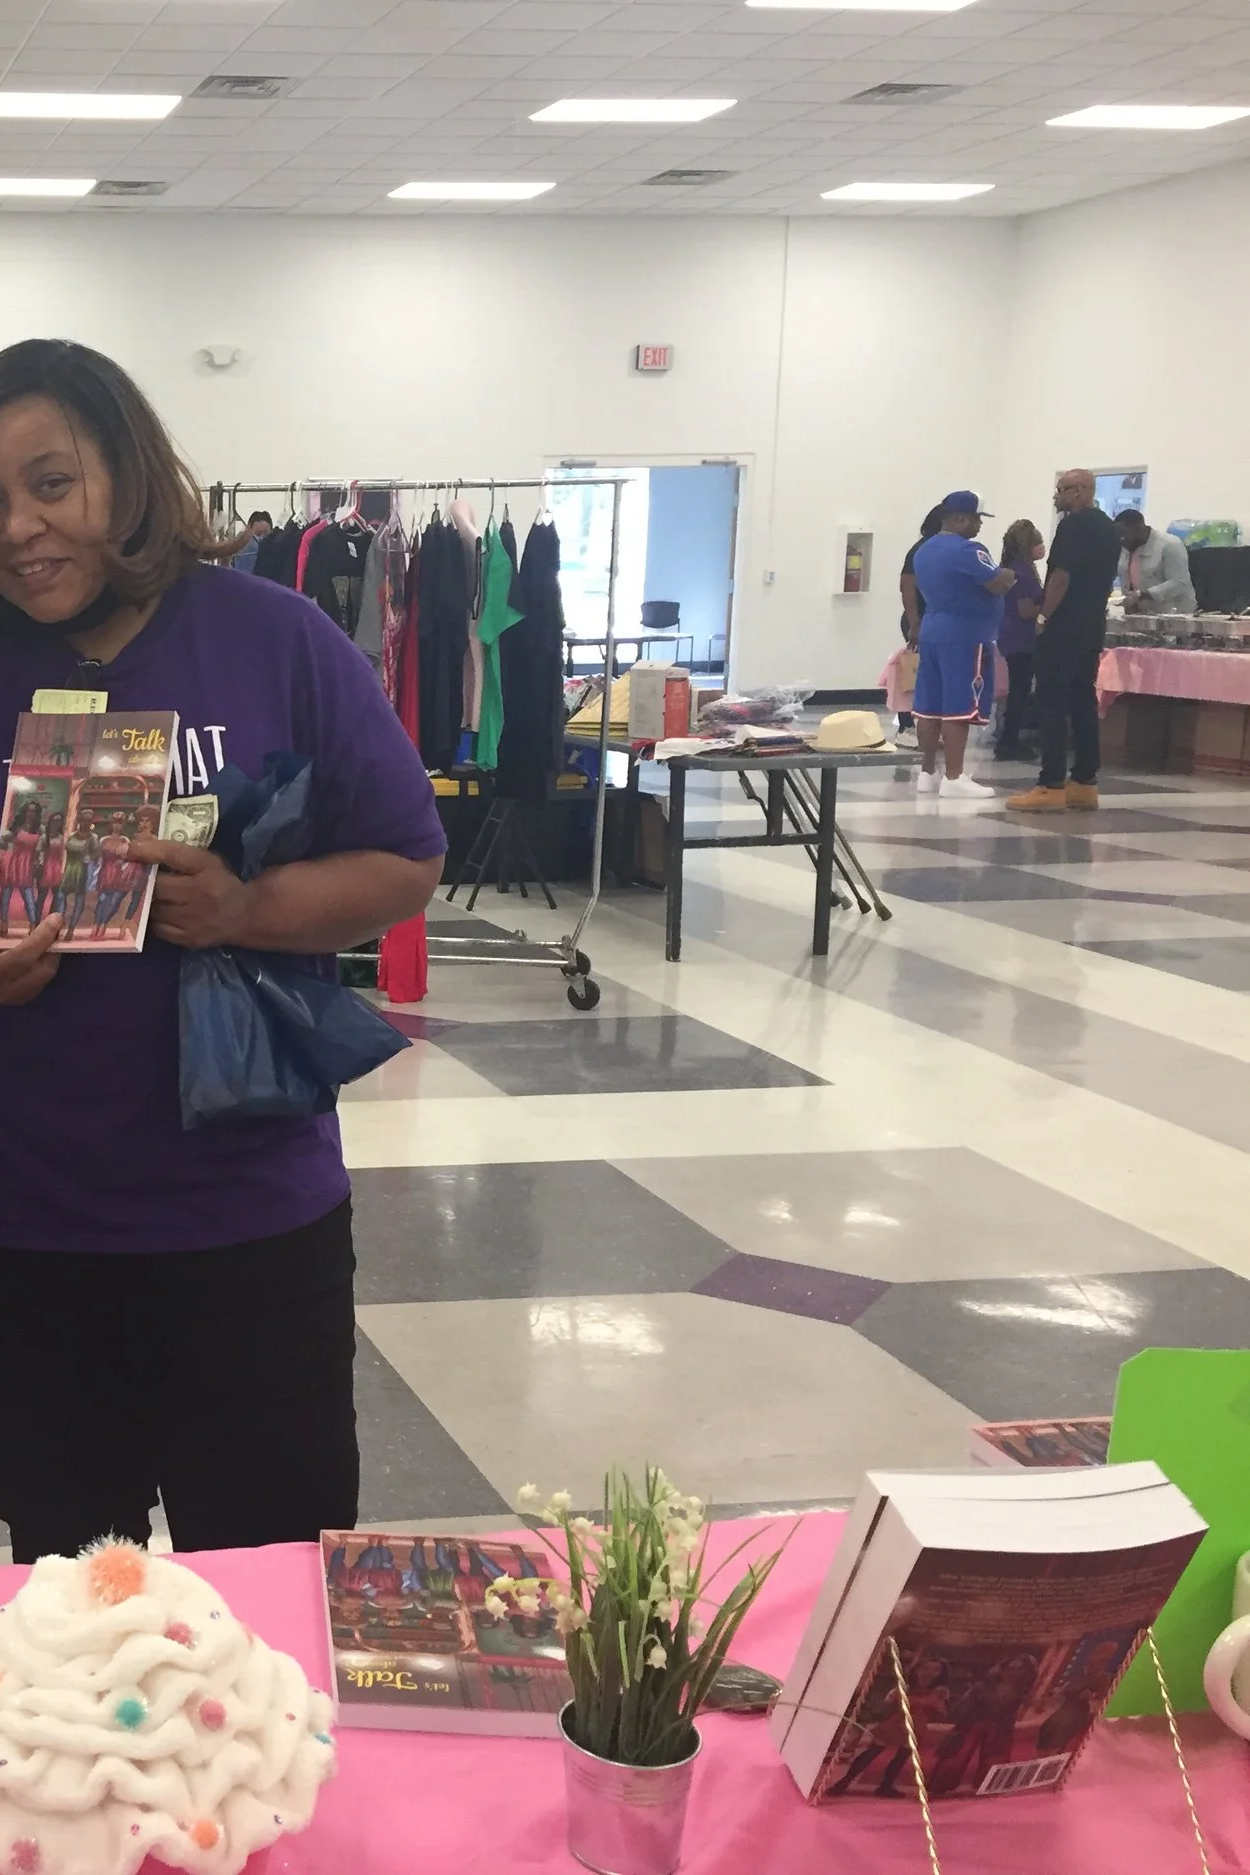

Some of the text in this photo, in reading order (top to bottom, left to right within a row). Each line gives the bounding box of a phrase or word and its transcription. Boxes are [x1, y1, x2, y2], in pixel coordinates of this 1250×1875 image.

[643, 347, 669, 366] EXIT
[121, 728, 165, 752] Talk
[347, 1668, 418, 1691] Talk
